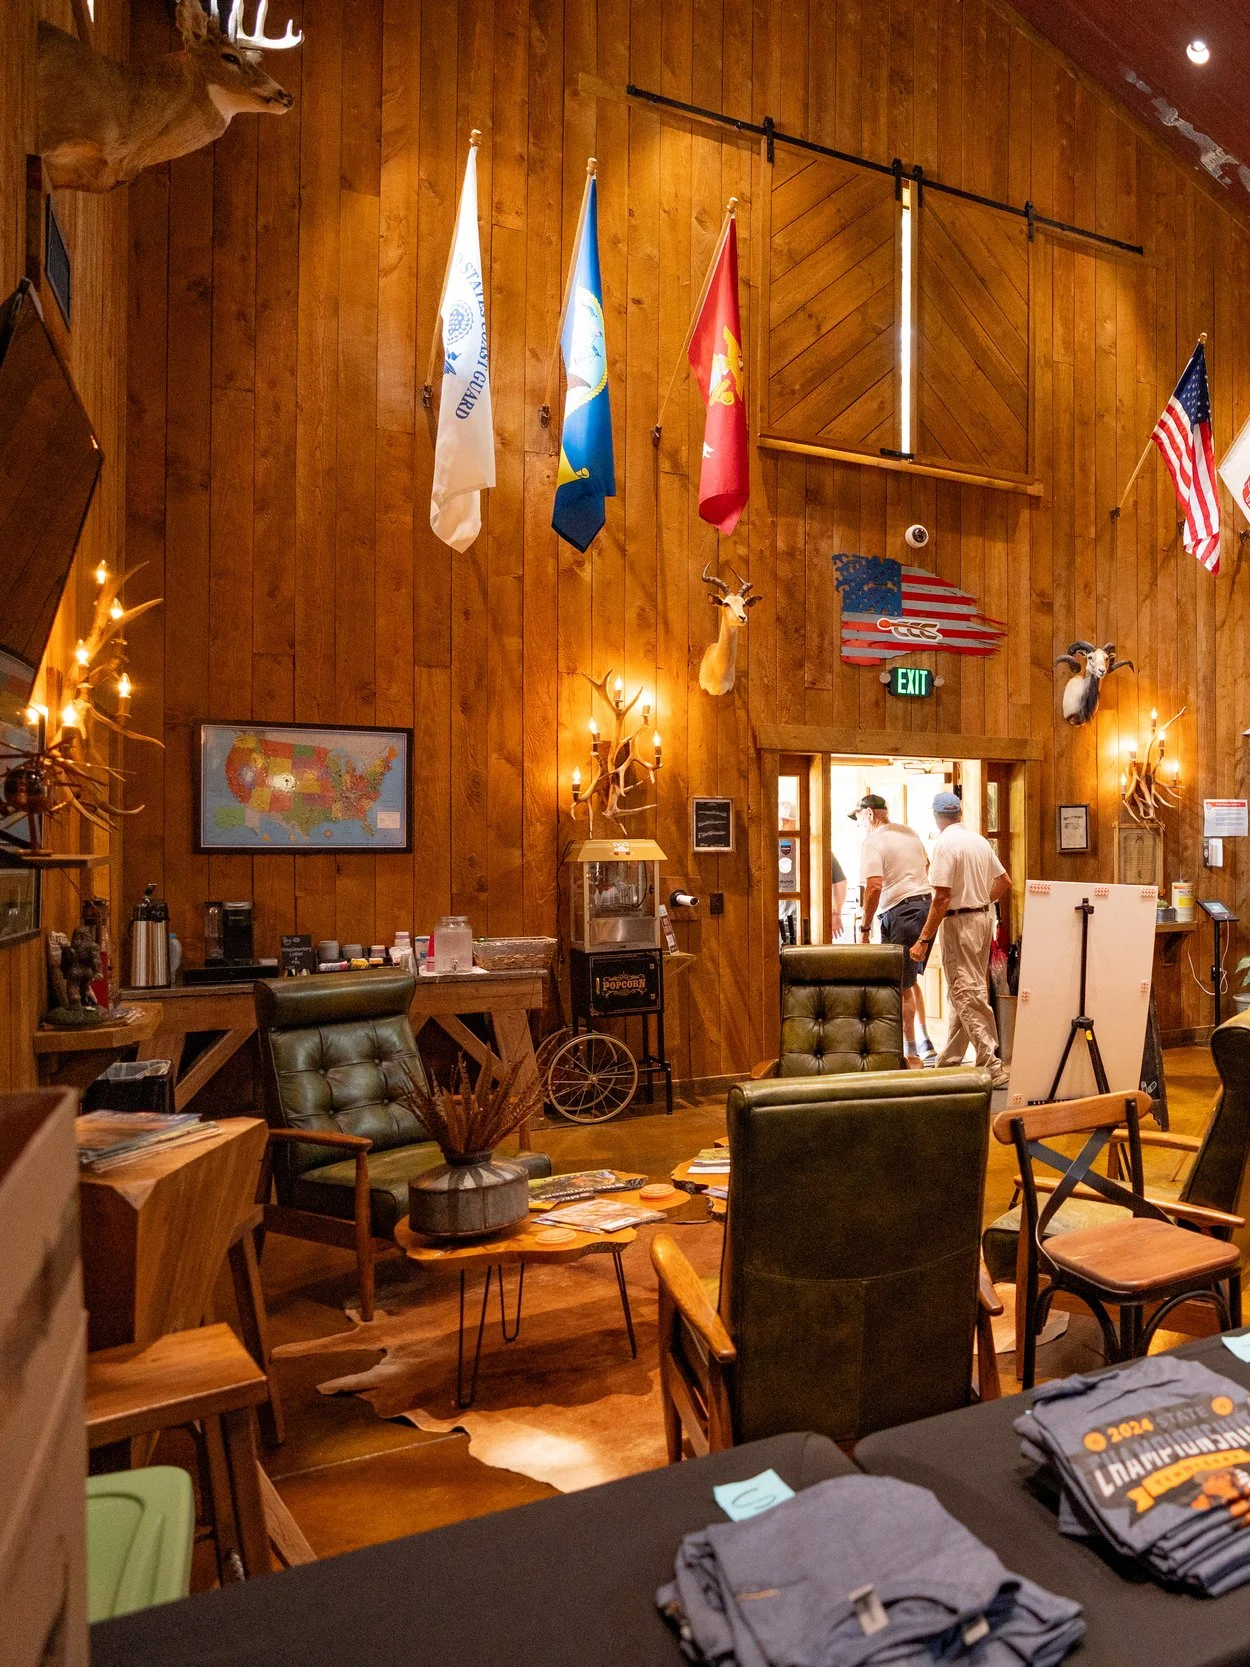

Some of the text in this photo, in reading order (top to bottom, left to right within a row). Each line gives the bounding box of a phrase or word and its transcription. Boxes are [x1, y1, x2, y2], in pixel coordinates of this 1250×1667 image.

[455, 370, 487, 420] GUARD
[897, 668, 928, 696] EXIT
[602, 978, 646, 991] POPCORN
[1106, 1406, 1209, 1444] 2024 STATE
